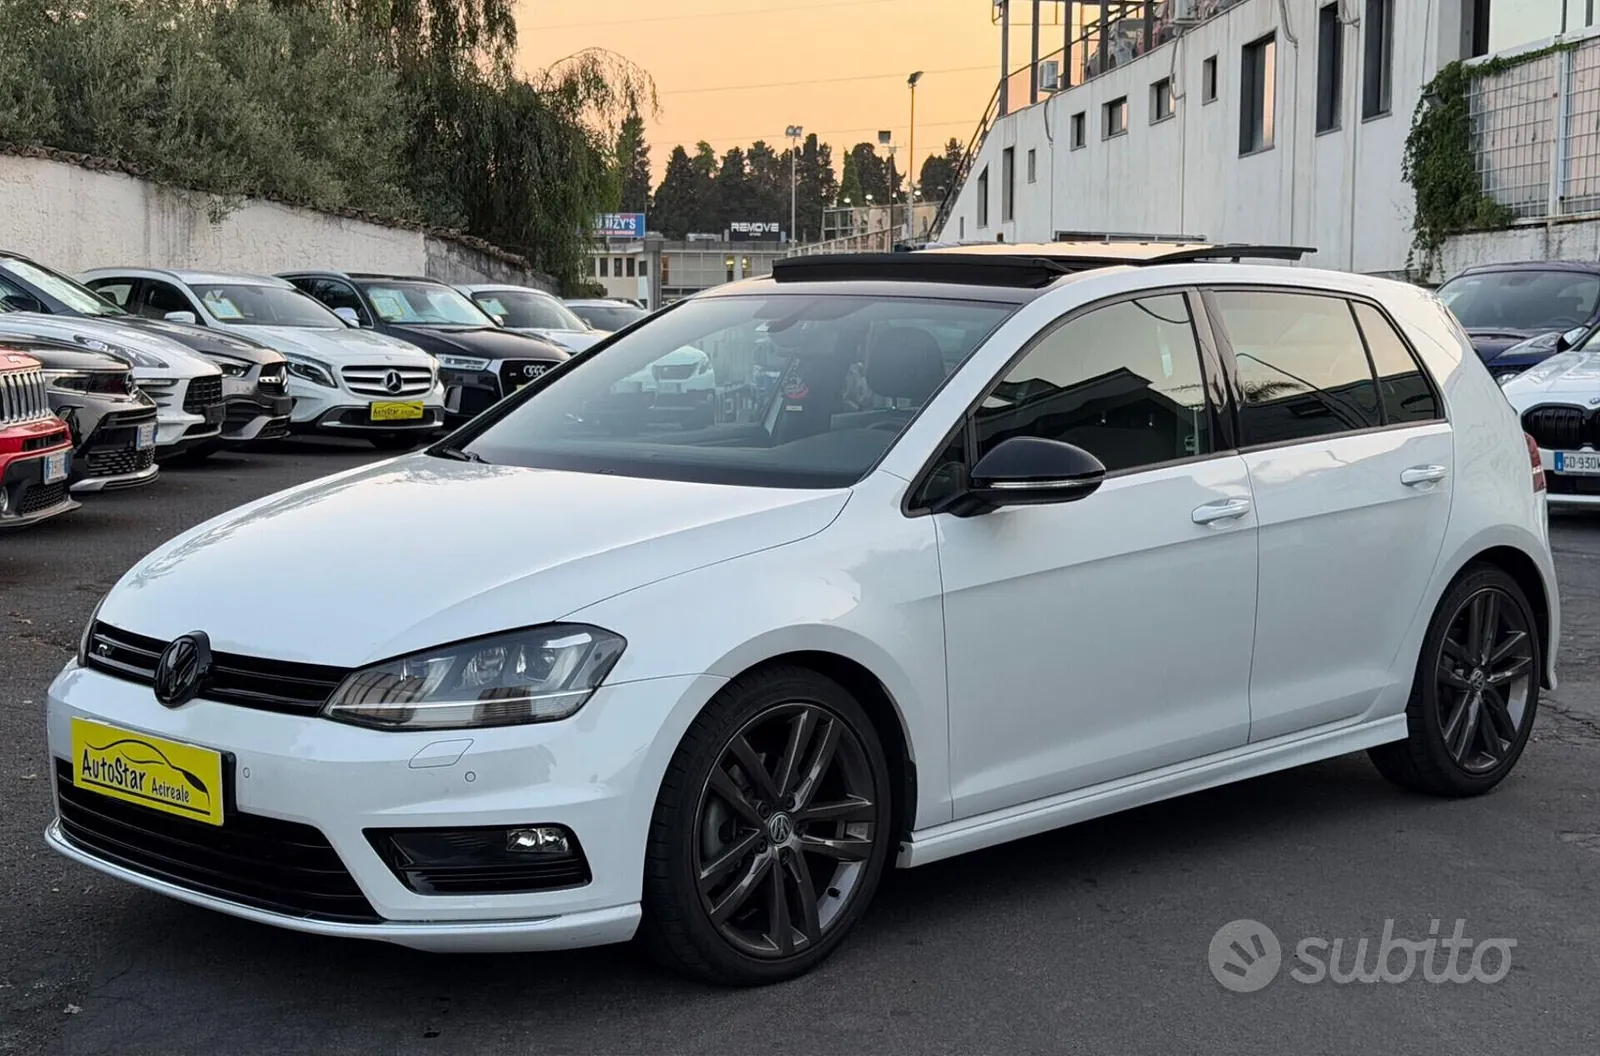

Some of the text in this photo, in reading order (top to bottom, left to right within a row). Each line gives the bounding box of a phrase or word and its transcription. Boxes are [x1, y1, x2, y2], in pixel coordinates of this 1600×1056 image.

[731, 222, 779, 233] REMOVE
[82, 748, 190, 803] AutoStar Acireale
